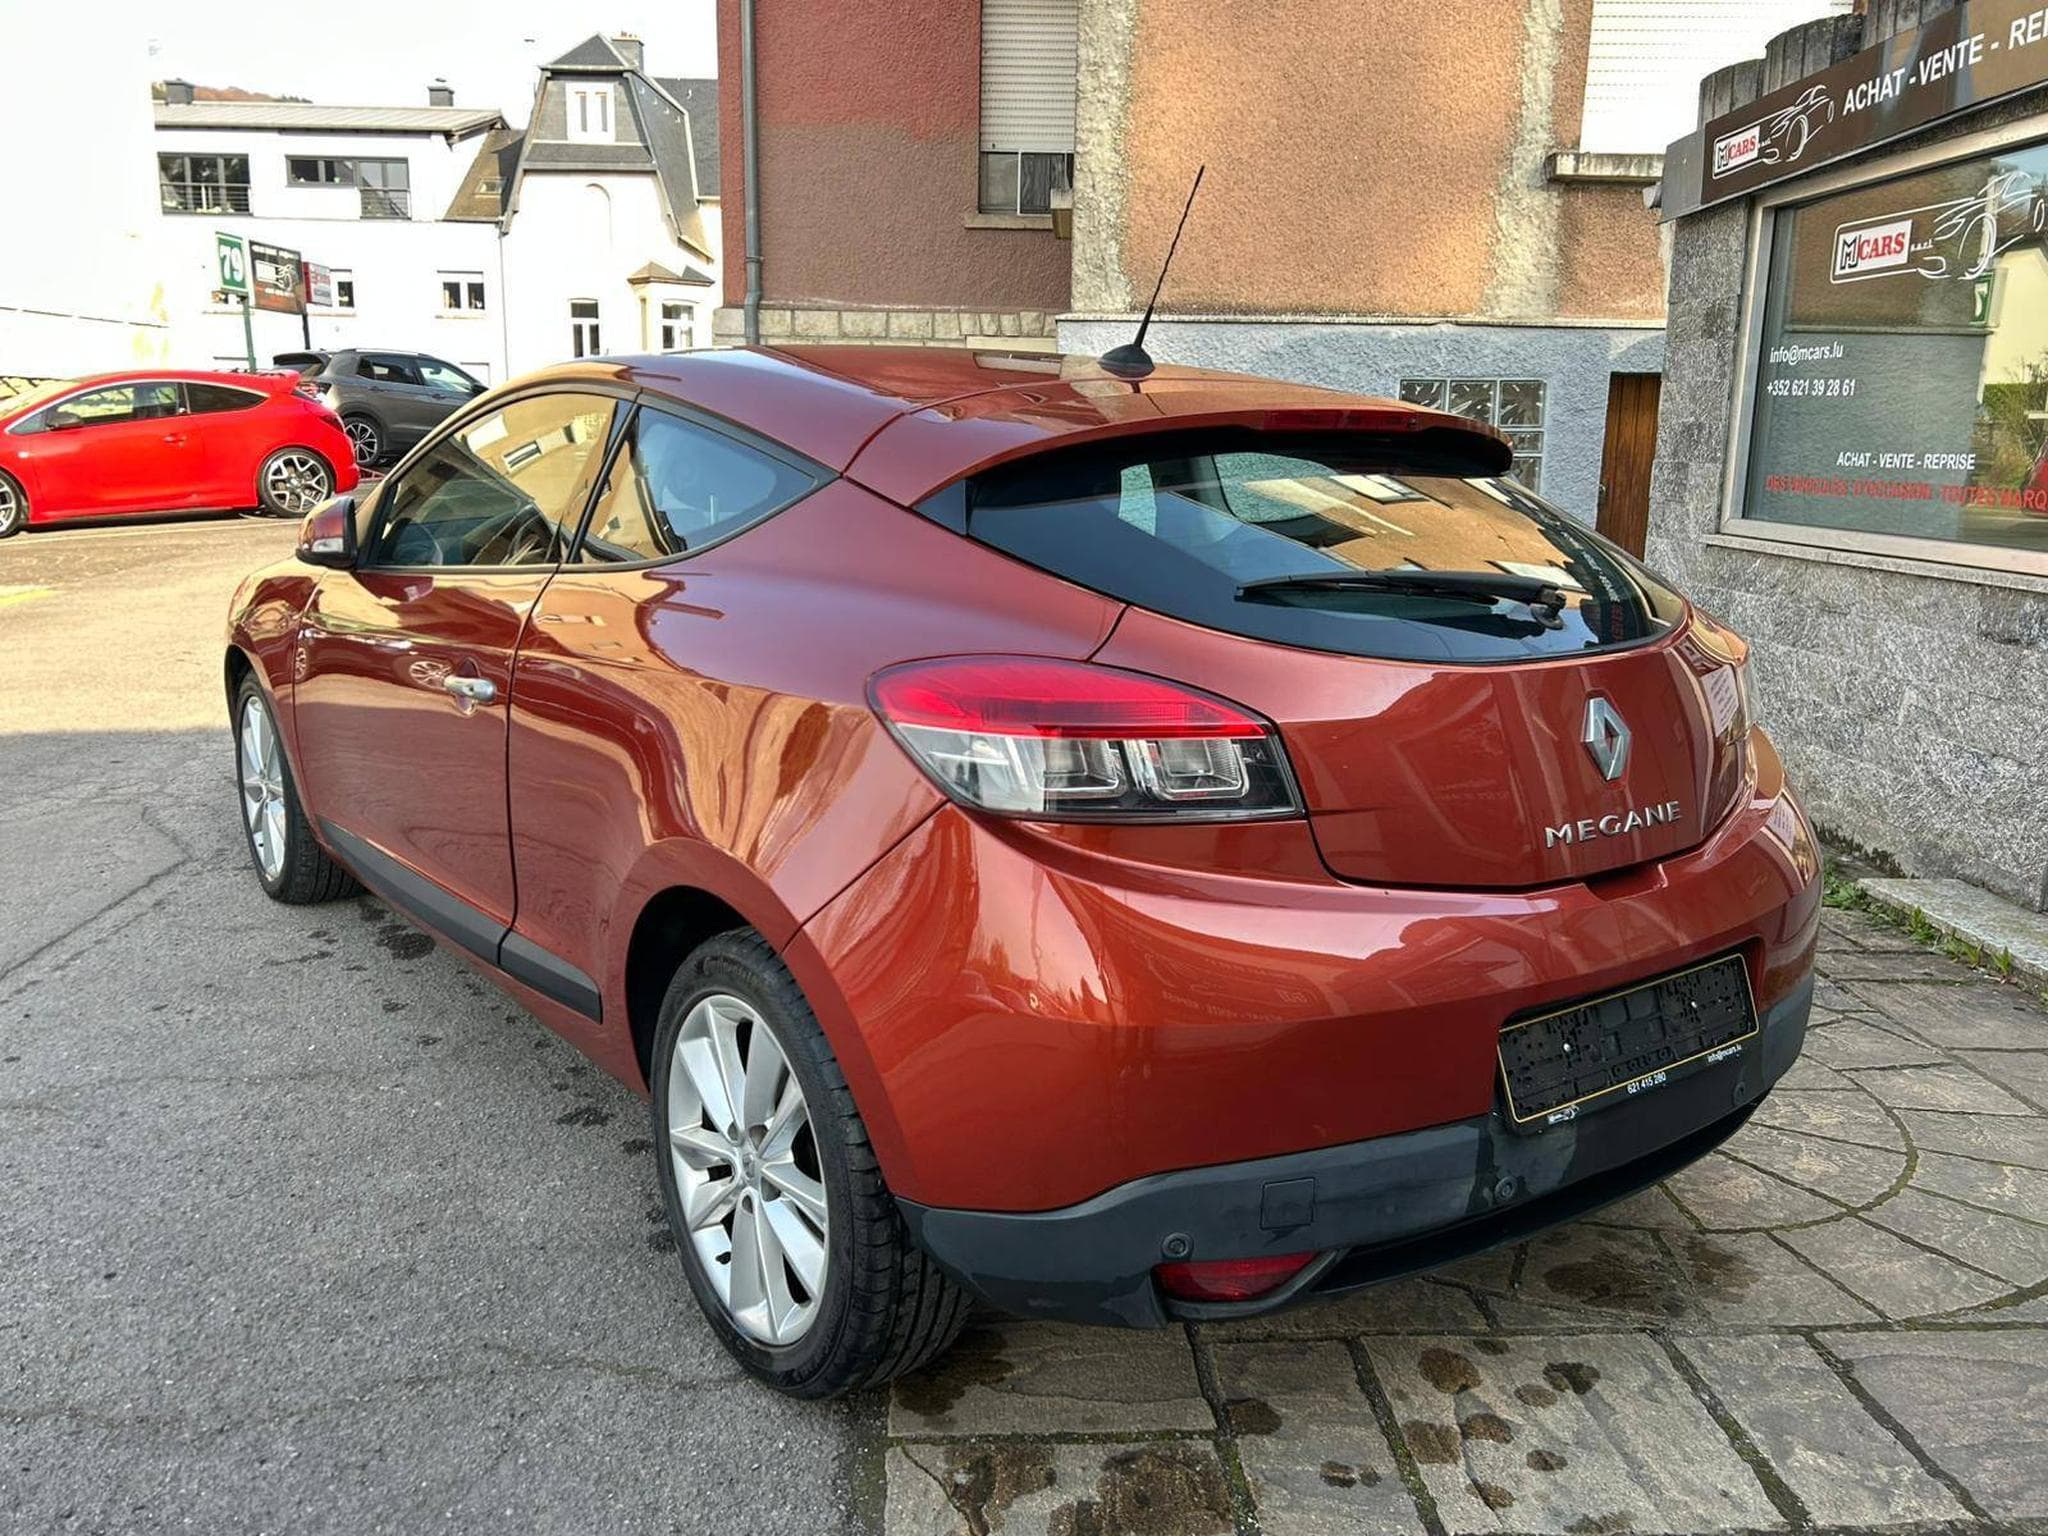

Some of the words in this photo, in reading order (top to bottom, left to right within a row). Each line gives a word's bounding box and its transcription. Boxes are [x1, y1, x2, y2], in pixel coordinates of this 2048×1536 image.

[1842, 67, 1906, 116] ACHAT
[1919, 33, 1985, 86] VENTE
[219, 244, 245, 282] 79
[1769, 341, 1844, 366] info@mcars.lu
[1766, 380, 1791, 396] +352
[1791, 379, 1810, 396] 621
[1812, 379, 1825, 396] 39
[1826, 379, 1841, 396] 28
[1842, 379, 1856, 396] 61
[1836, 451, 1871, 467] ACHAT
[1879, 453, 1915, 469] VENTE
[1923, 453, 1976, 470] REPRISE
[1545, 801, 1682, 848] MEGANE
[1627, 1082, 1641, 1094] 621
